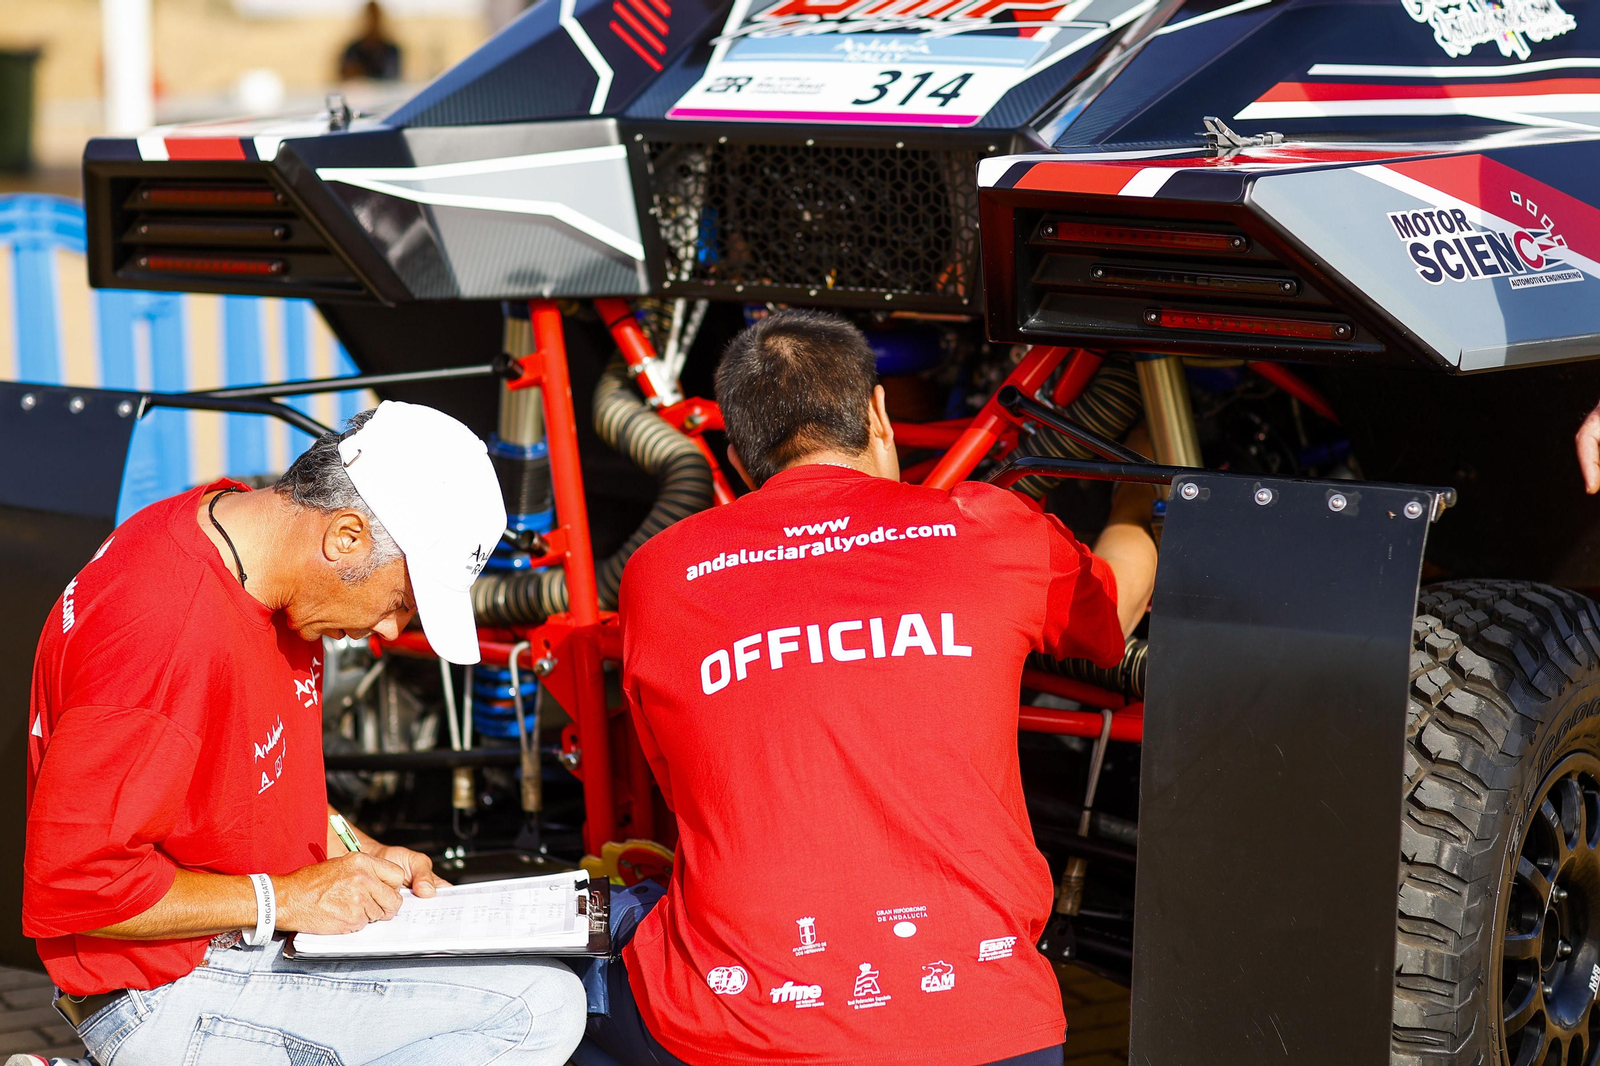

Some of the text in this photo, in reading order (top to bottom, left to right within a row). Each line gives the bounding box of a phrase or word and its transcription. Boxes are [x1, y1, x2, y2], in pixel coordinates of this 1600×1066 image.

[852, 70, 975, 107] 314
[1390, 208, 1473, 239] MOTOR
[1511, 271, 1582, 287] AUTOMOTIVE ENGINEERING
[783, 516, 850, 538] www
[686, 523, 957, 581] andaluciarallyodc.com
[699, 612, 973, 696] OFFICIAL
[709, 969, 745, 991] FIA
[770, 981, 823, 1003] rfme
